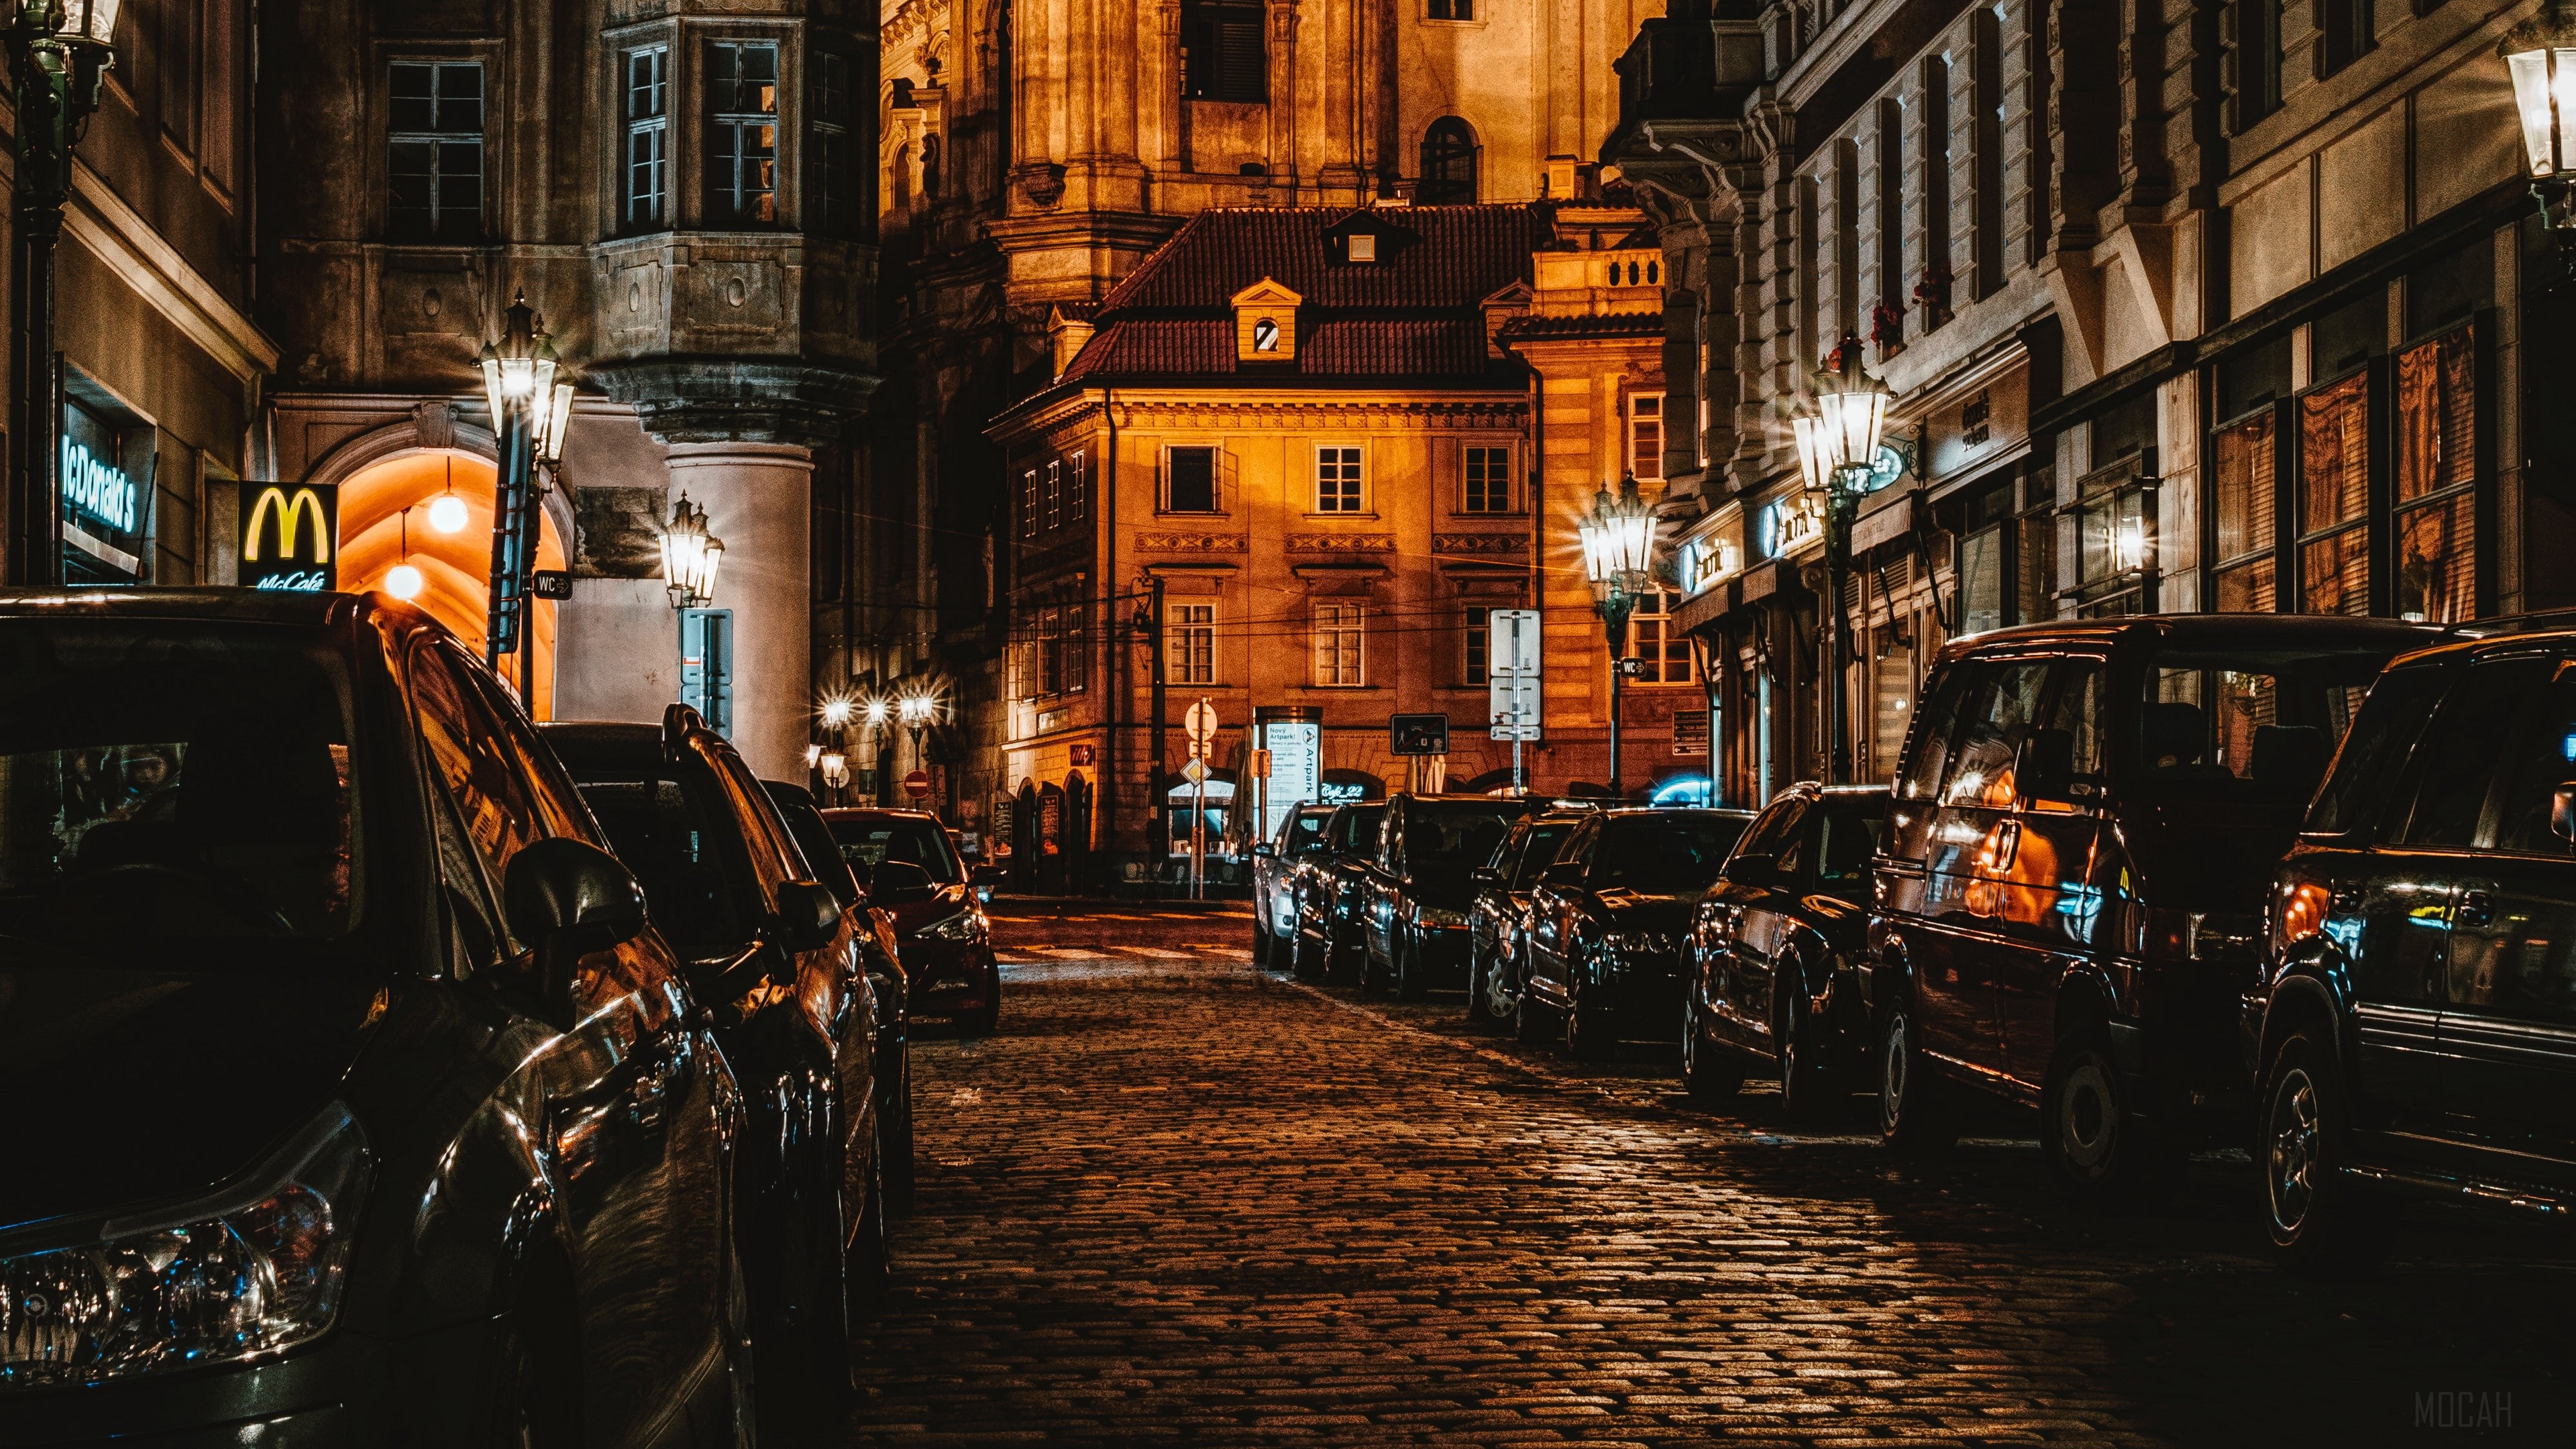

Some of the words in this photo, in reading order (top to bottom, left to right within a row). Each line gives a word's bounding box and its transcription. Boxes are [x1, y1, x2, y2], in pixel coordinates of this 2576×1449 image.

[539, 576, 555, 592] WC
[1623, 661, 1635, 673] WC
[1304, 748, 1314, 793] Artpark
